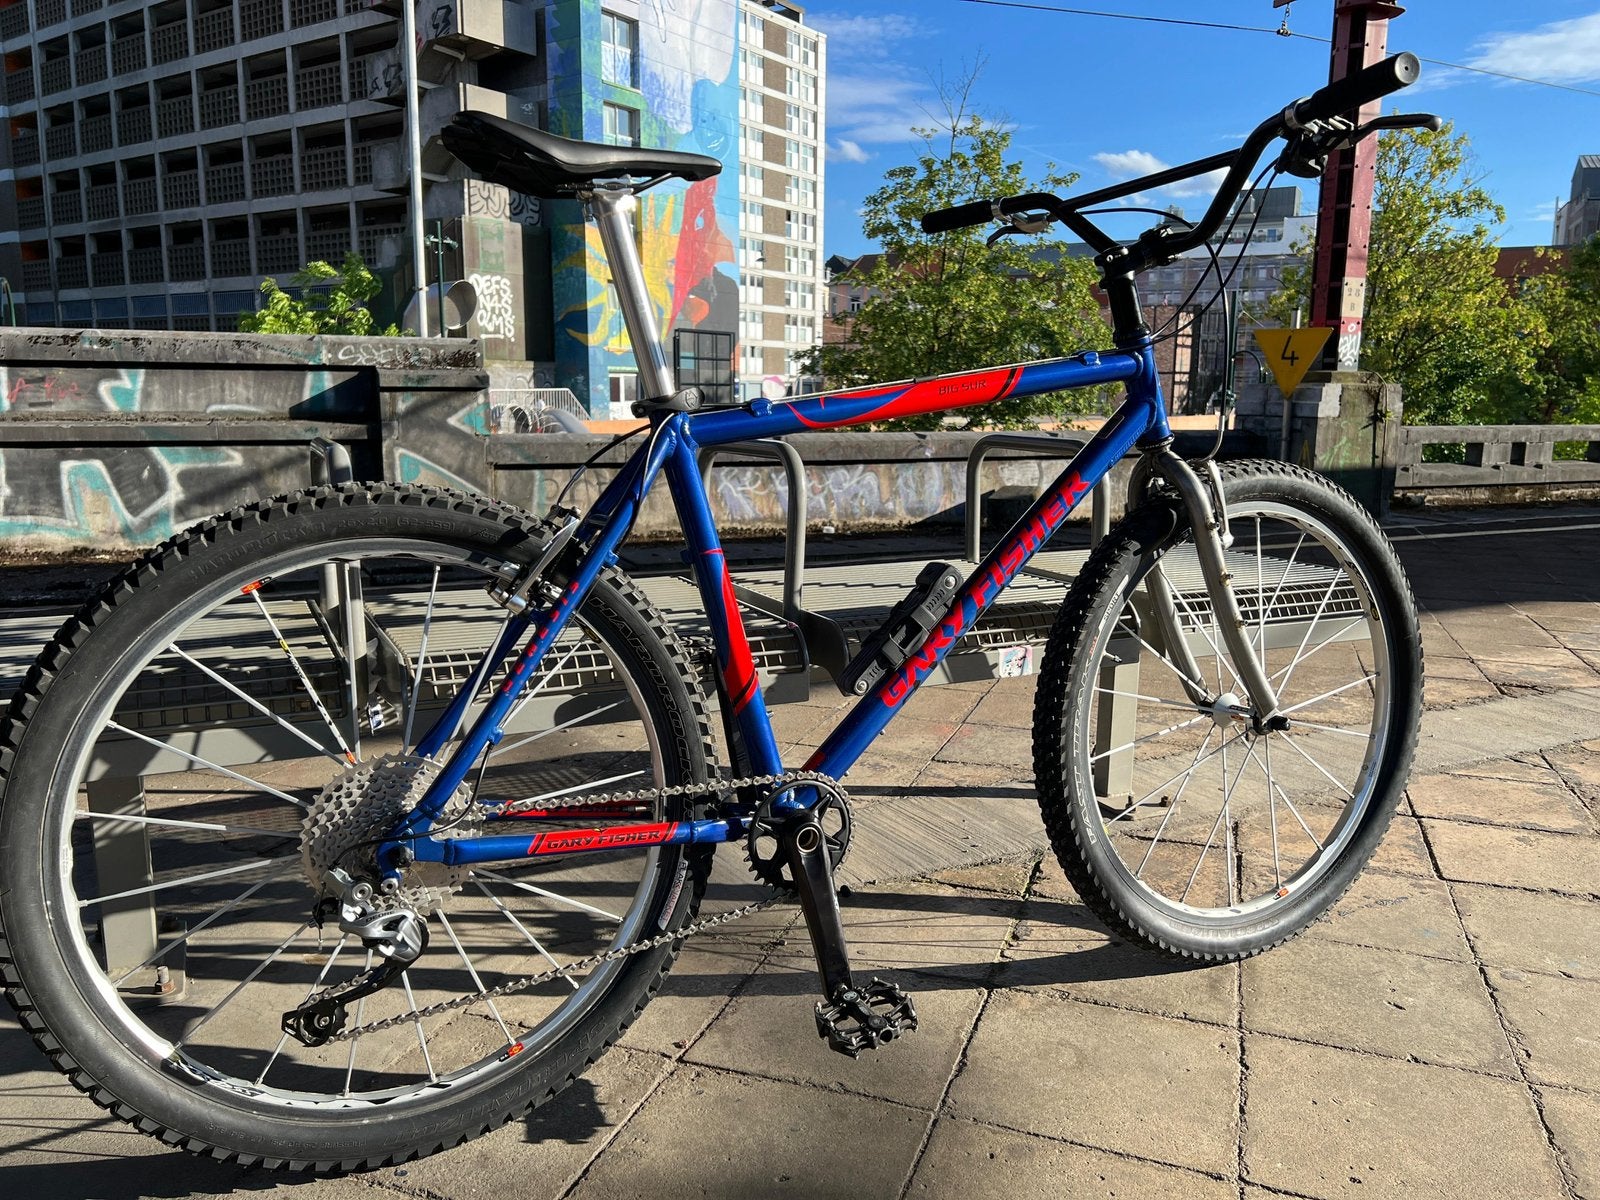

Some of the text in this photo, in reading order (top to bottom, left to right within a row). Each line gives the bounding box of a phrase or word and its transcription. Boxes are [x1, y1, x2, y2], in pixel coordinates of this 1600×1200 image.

[1281, 335, 1299, 367] 4
[938, 379, 988, 396] BIG SUR
[879, 470, 1091, 708] GARY FISHER
[1074, 766, 1098, 845] FAST
[547, 830, 661, 850] GARY FISHER
